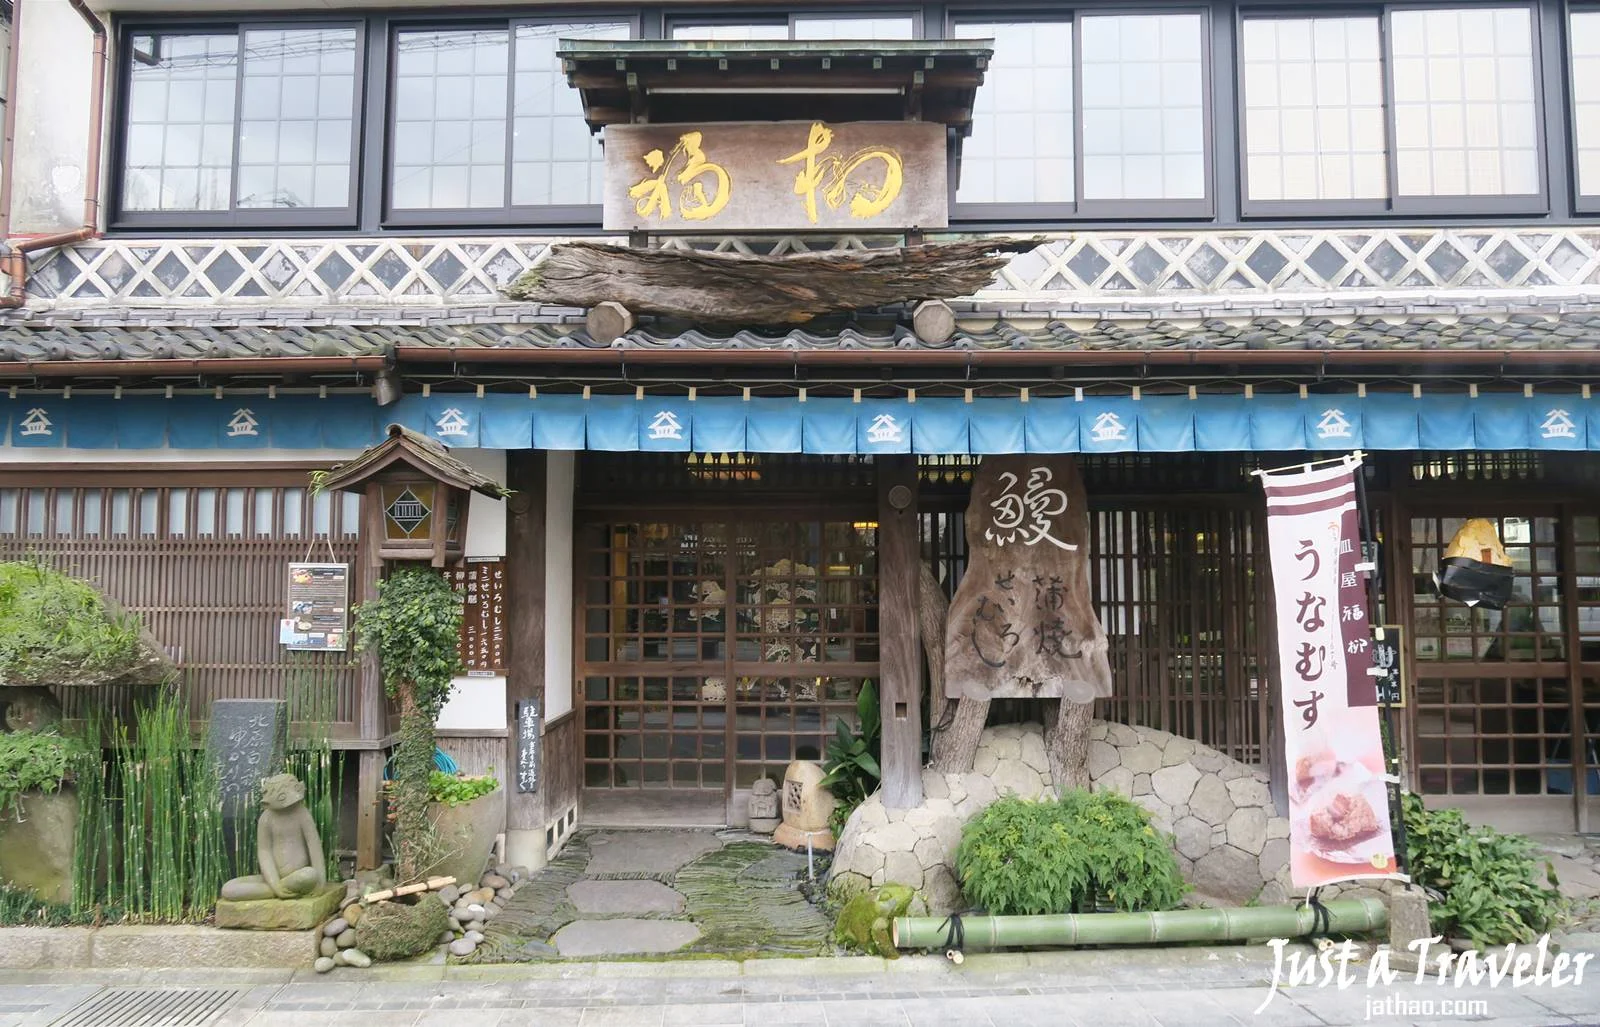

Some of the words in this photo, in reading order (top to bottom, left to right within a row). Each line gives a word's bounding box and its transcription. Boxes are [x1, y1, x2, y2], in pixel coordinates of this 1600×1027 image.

[985, 466, 1078, 550] 鰻
[1293, 539, 1326, 731] うなむす
